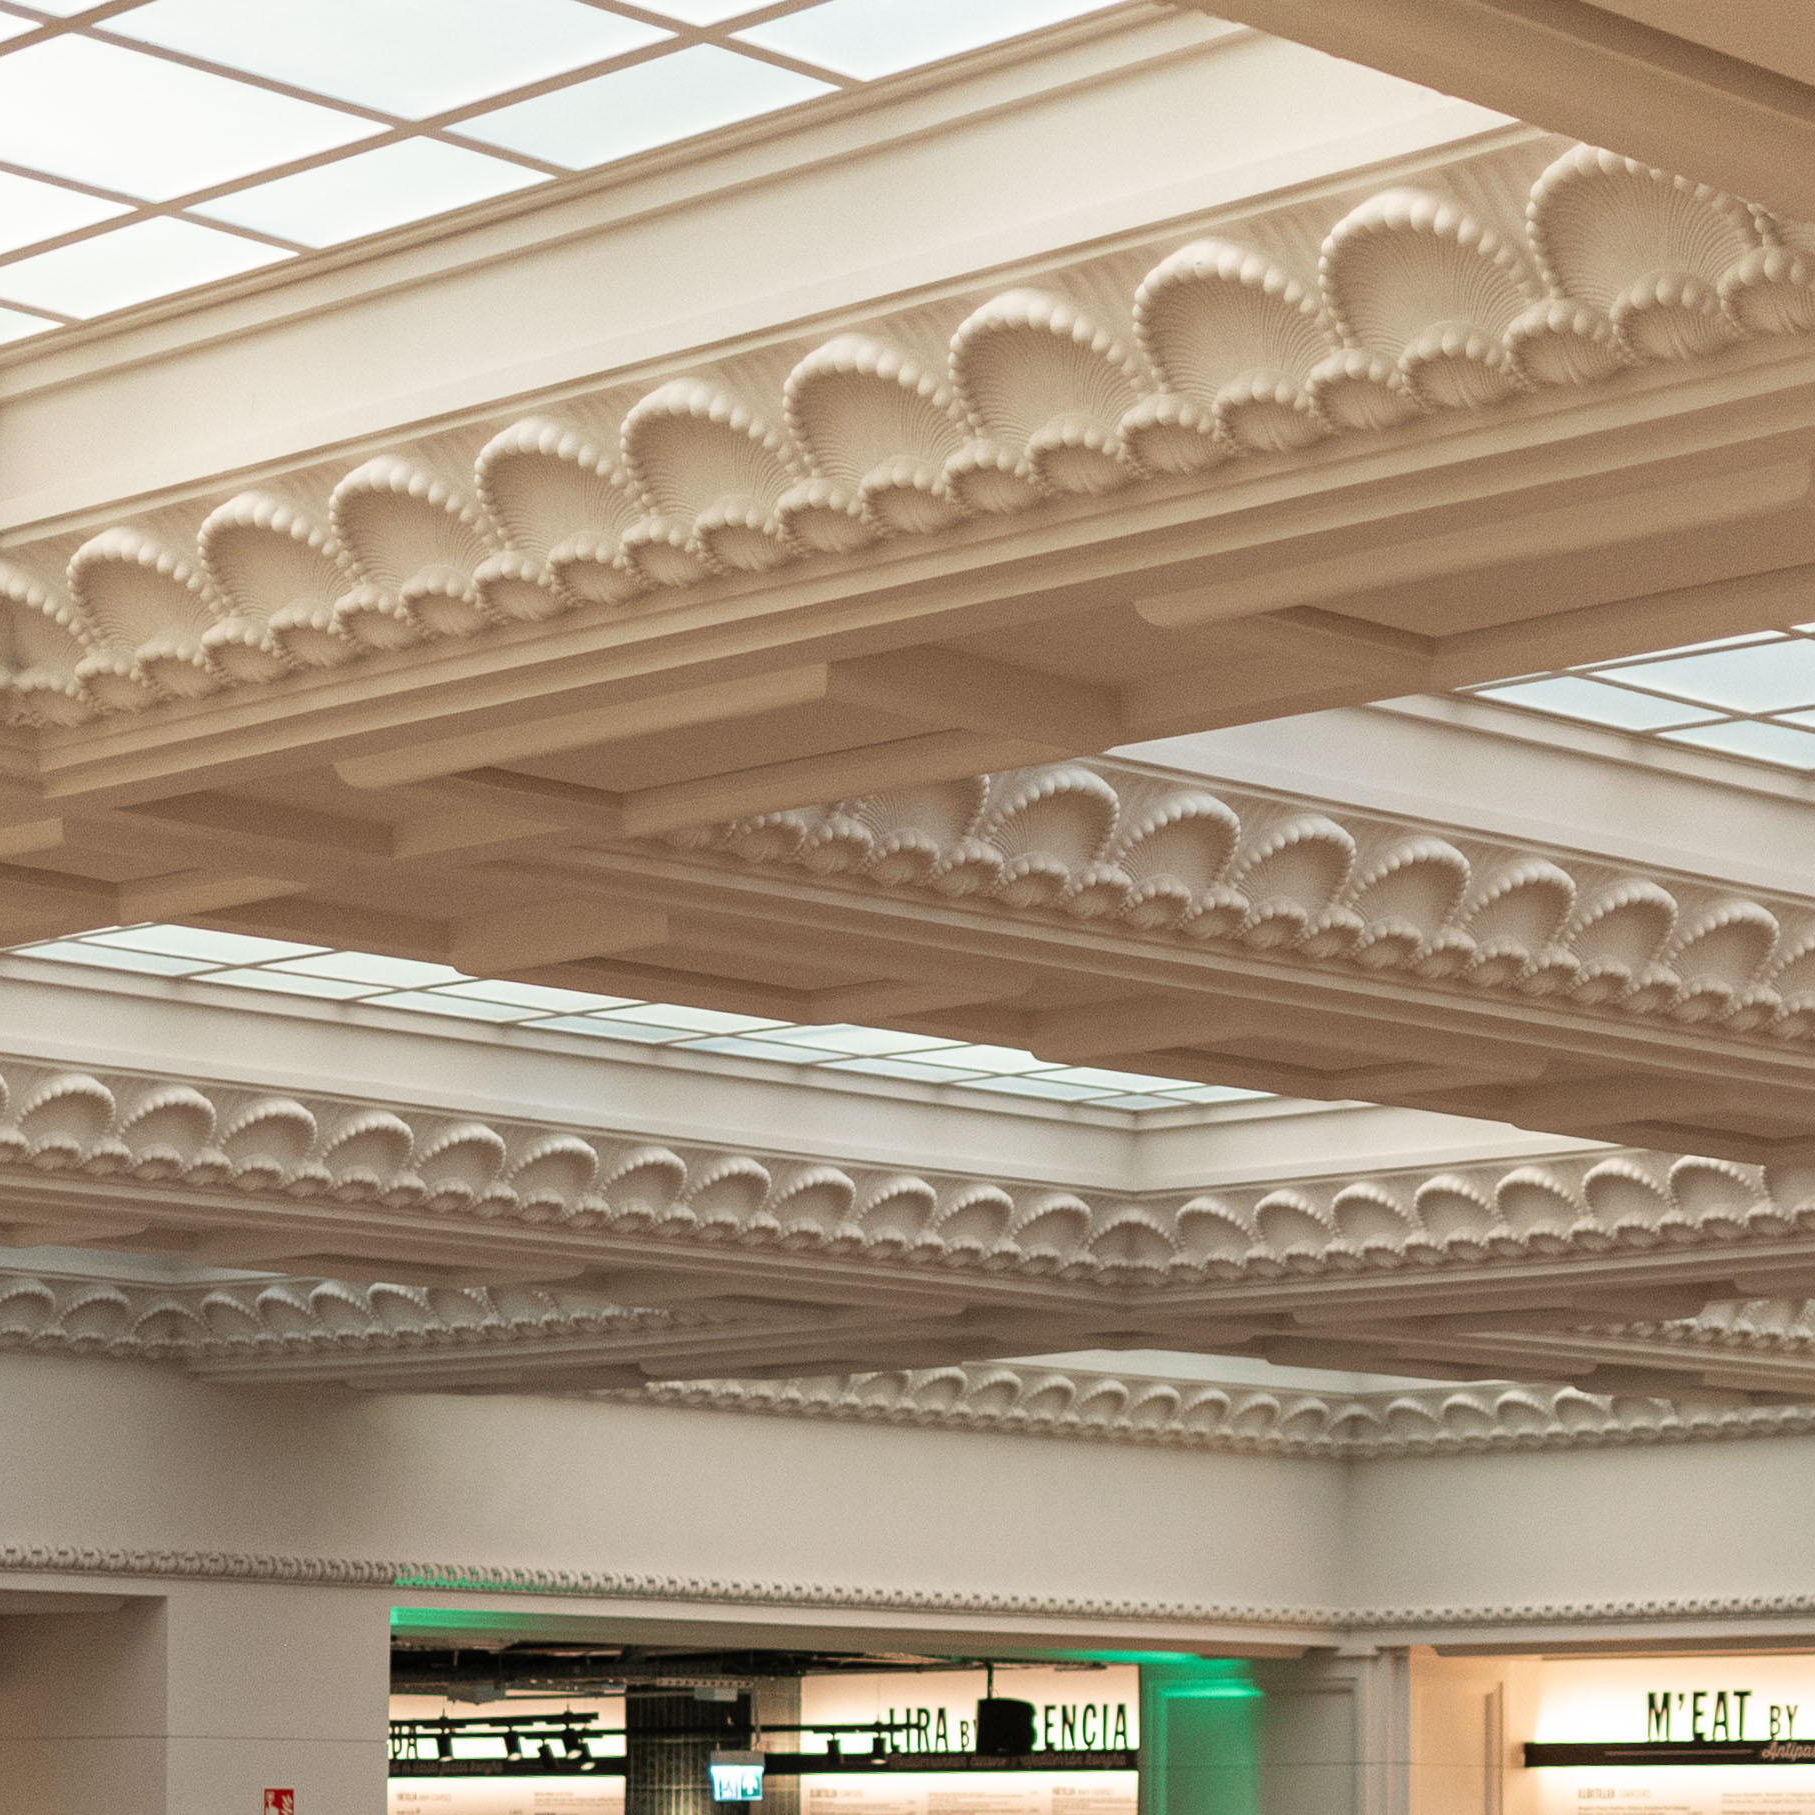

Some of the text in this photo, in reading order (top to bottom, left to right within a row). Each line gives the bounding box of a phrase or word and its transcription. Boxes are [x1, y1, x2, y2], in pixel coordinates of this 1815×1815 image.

[961, 1720, 977, 1748] B
[1031, 1703, 1130, 1751] ENCIA
[1770, 1704, 1799, 1739] BY
